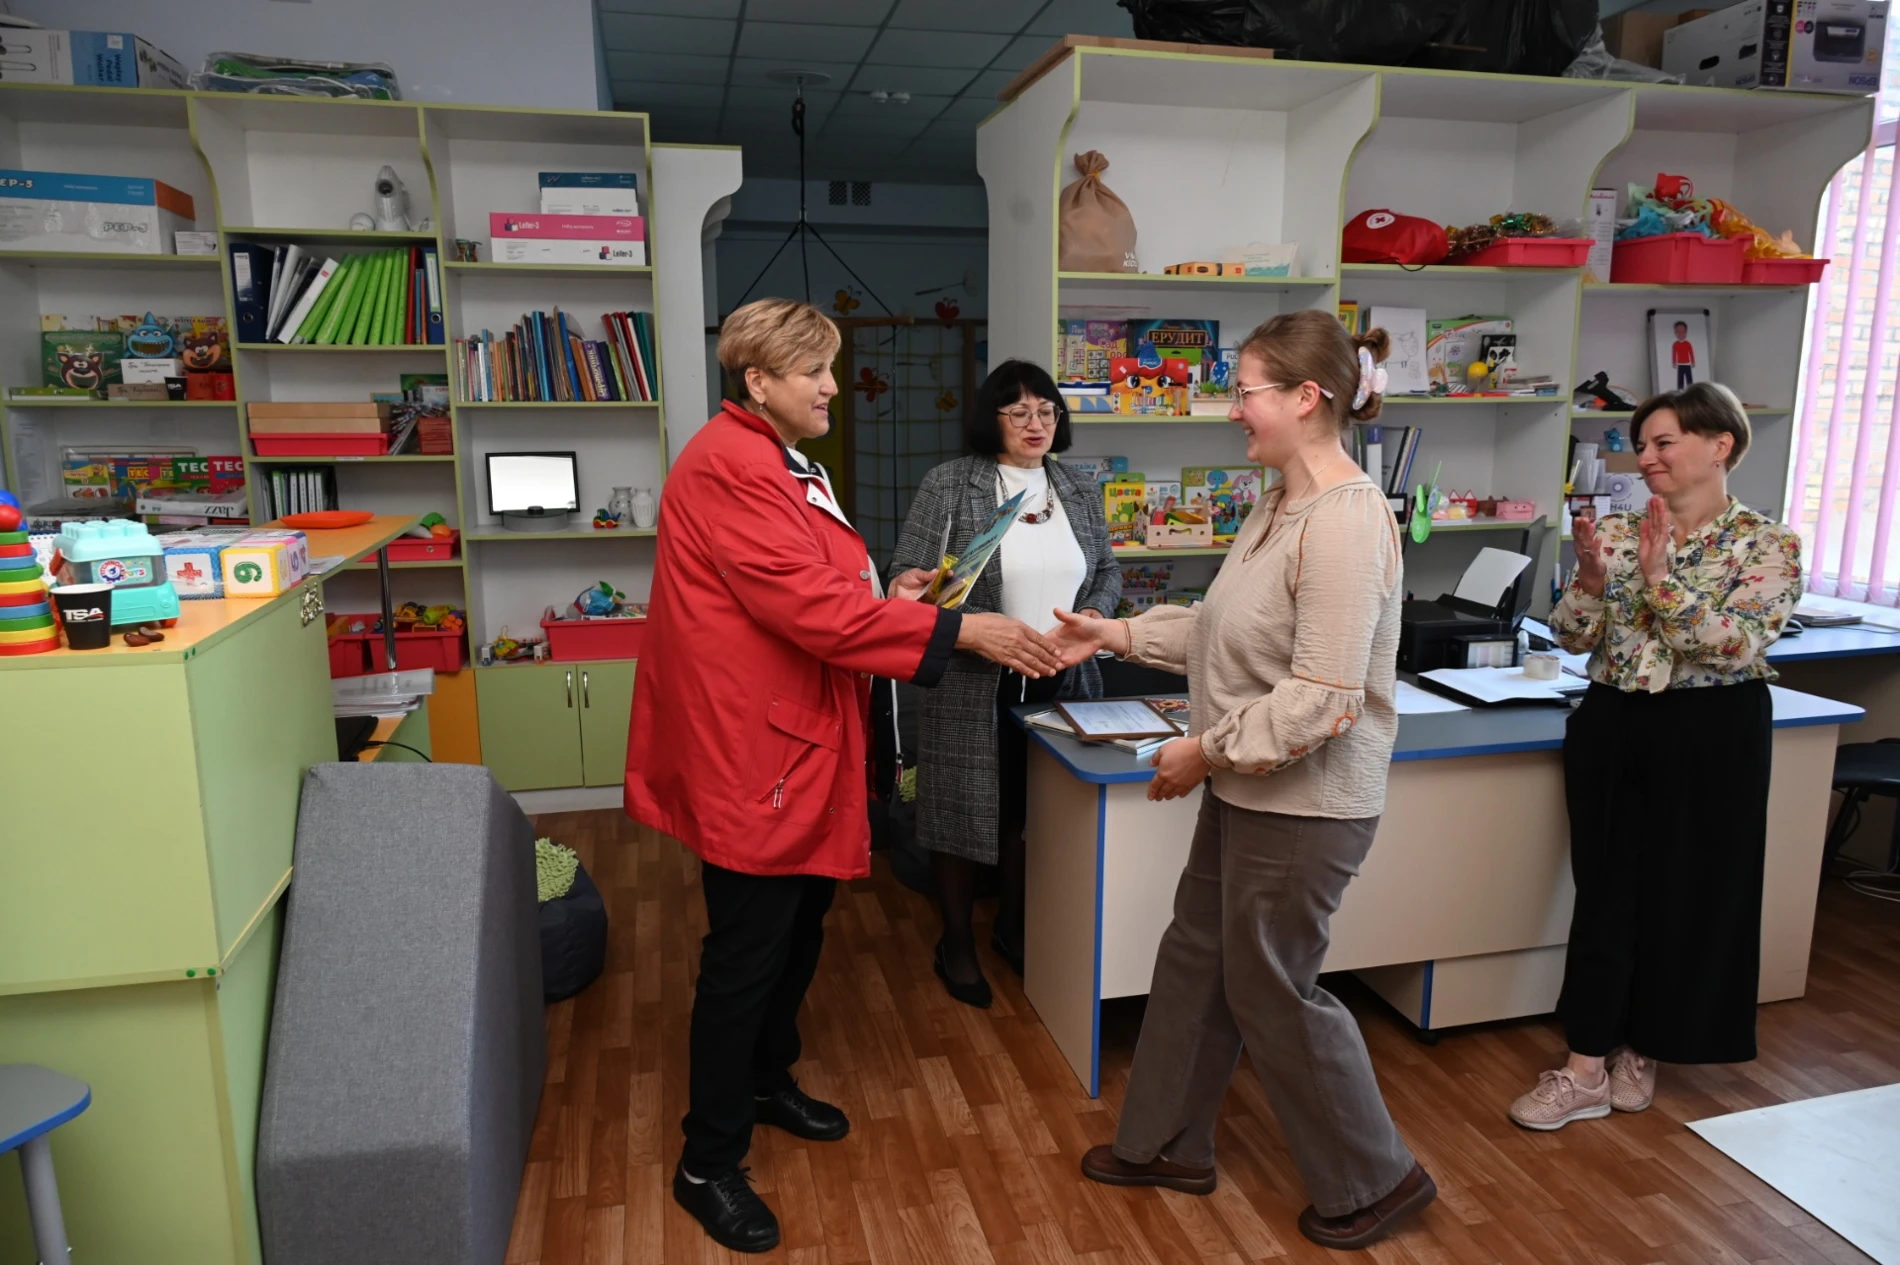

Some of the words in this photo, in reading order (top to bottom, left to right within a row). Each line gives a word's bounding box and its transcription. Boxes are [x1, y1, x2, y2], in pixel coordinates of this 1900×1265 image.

[114, 53, 122, 83] Weplay
[103, 221, 148, 233] PEP-3
[1151, 330, 1205, 346] ЕРУДИТ
[1109, 488, 1141, 497] Цвета
[63, 607, 105, 621] TSA
